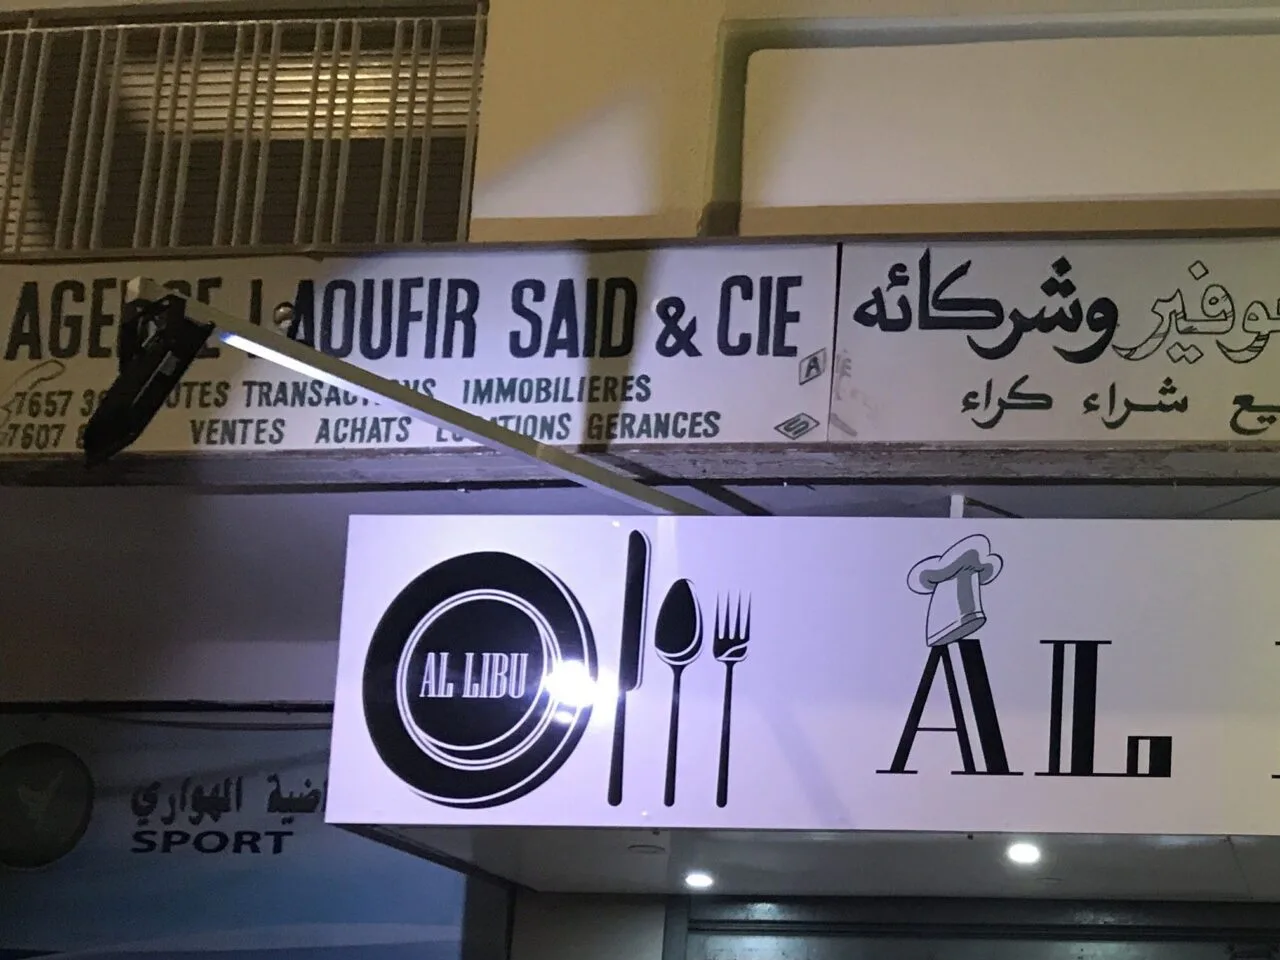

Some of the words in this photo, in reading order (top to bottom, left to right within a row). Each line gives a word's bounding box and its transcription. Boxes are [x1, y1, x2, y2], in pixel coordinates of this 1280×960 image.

[4, 276, 222, 361] AGEE
[508, 276, 638, 358] SAID
[654, 295, 702, 358] &
[716, 274, 802, 357] CIE
[852, 247, 1120, 364] وشركائه
[462, 374, 652, 406] IMMOBILIERES
[960, 374, 1054, 430] كراء
[1081, 376, 1189, 430] شراء
[189, 418, 286, 446] VENTES
[315, 416, 412, 444] ACHATS
[586, 410, 722, 440] GERANCES
[418, 652, 454, 699] AL
[462, 651, 529, 699] LIBU
[876, 638, 1172, 777] AL
[130, 830, 294, 855] SPORT
